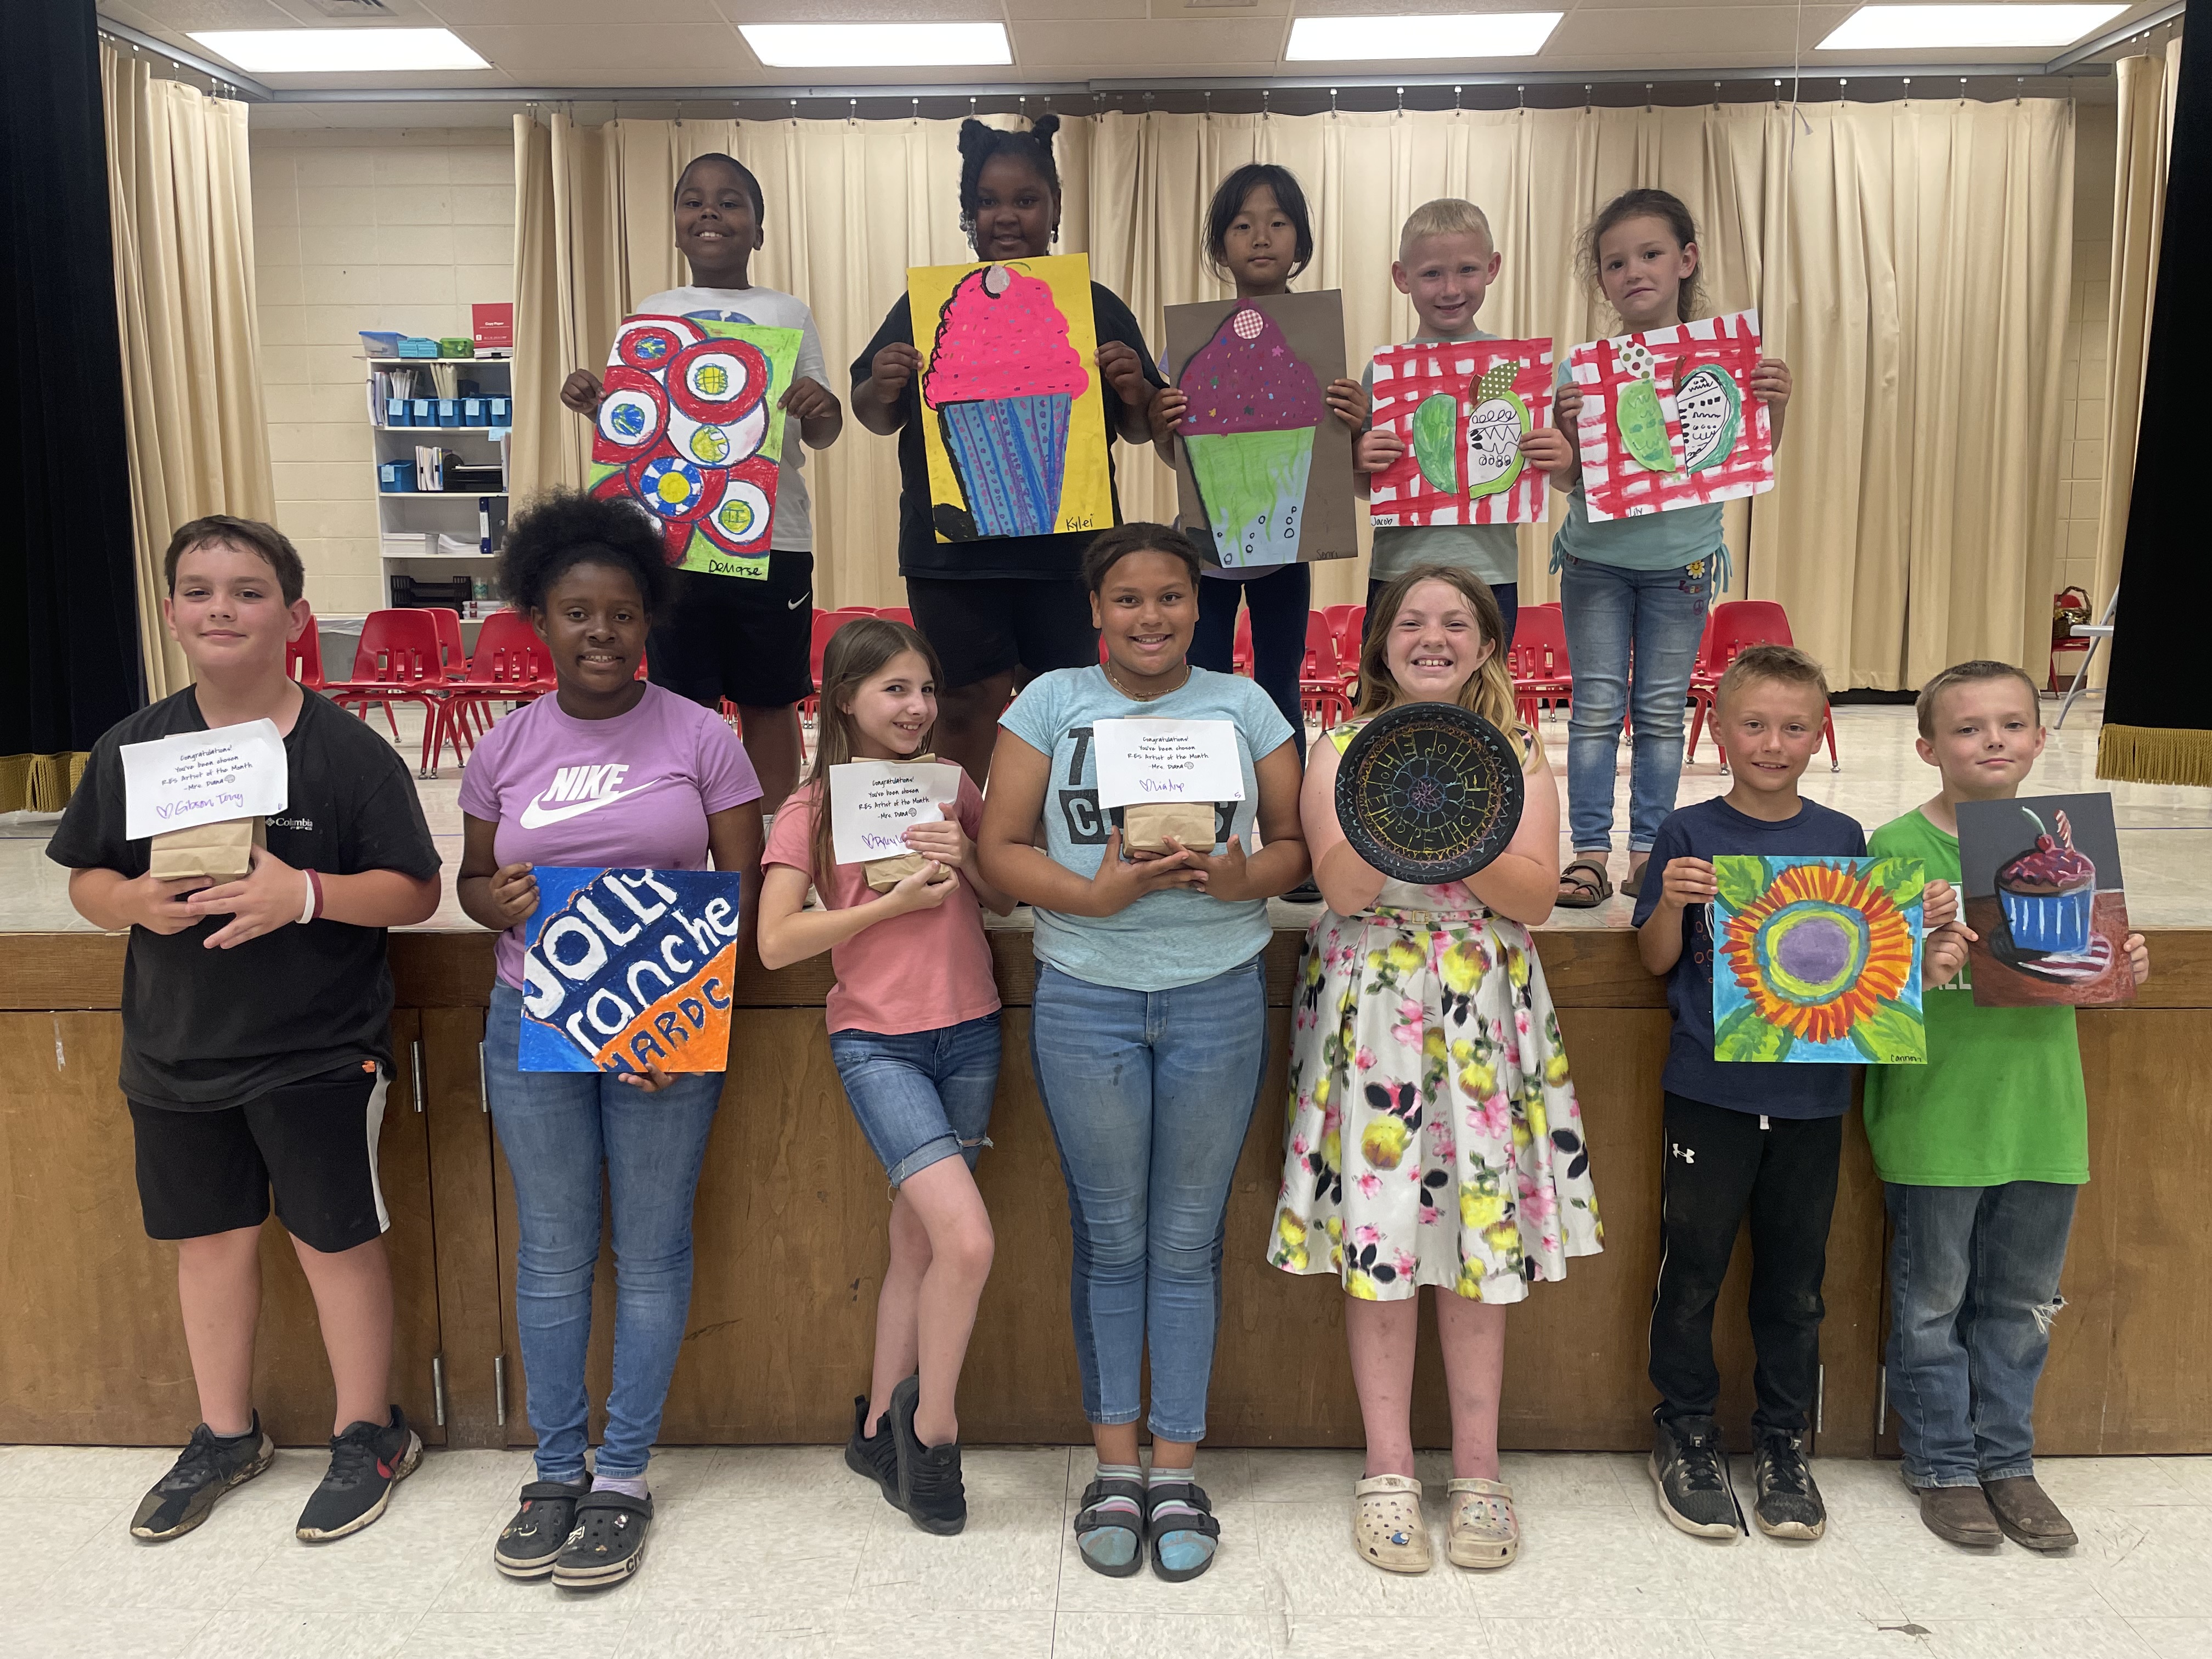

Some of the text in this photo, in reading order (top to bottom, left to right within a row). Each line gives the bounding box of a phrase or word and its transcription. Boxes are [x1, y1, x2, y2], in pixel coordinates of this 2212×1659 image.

[1066, 514, 1094, 532] Kylei
[1371, 516, 1393, 527] Jacob
[180, 744, 232, 761] Congratulations!
[181, 771, 204, 781] Artist
[231, 762, 253, 771] Month
[540, 764, 630, 802] NIKE
[872, 776, 914, 788] Congratulations!
[523, 868, 679, 1019] JOLLY
